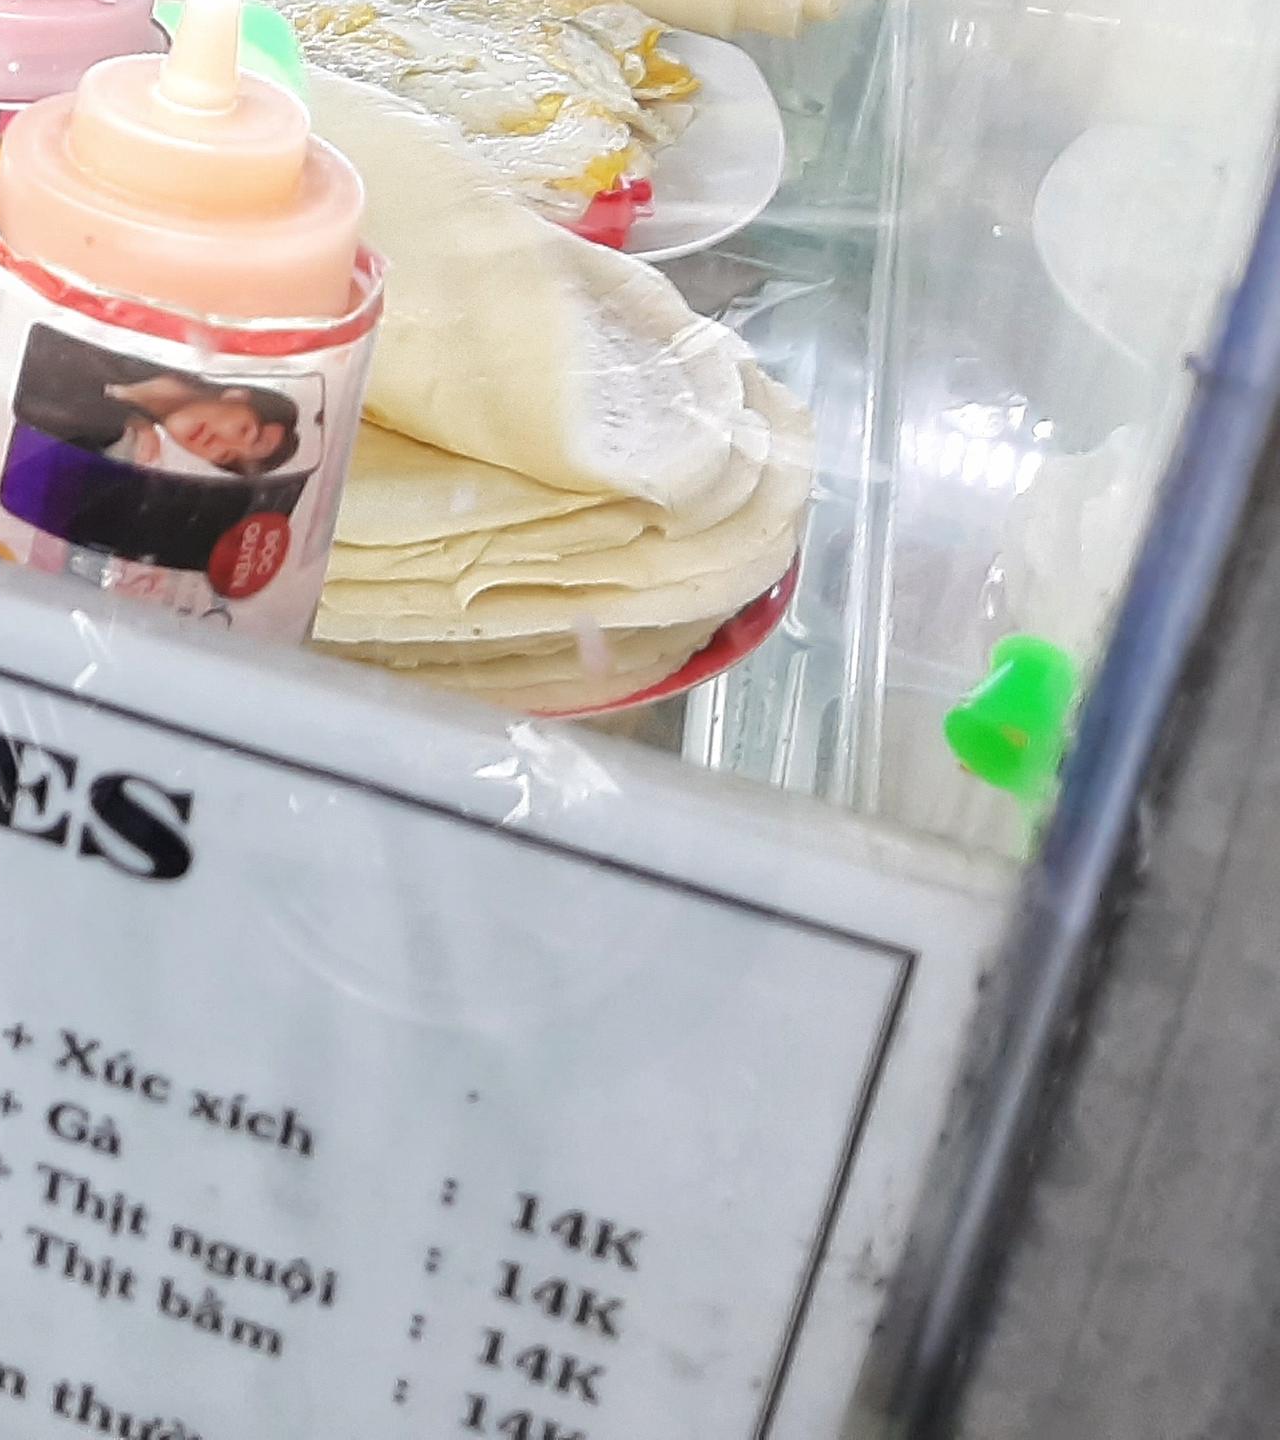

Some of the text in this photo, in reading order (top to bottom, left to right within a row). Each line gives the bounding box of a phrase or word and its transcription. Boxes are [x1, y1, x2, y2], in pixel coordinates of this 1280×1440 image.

[2, 1023, 34, 1051] +
[54, 1029, 171, 1105] Xúc
[189, 1090, 316, 1160] xích
[512, 1190, 645, 1272] 14K
[25, 1226, 138, 1302] Thịt
[44, 1101, 122, 1160] Gà
[496, 1260, 625, 1342] 14K
[36, 1162, 149, 1240] Thịt
[168, 1224, 338, 1309] nguội
[478, 1326, 605, 1406] 14K
